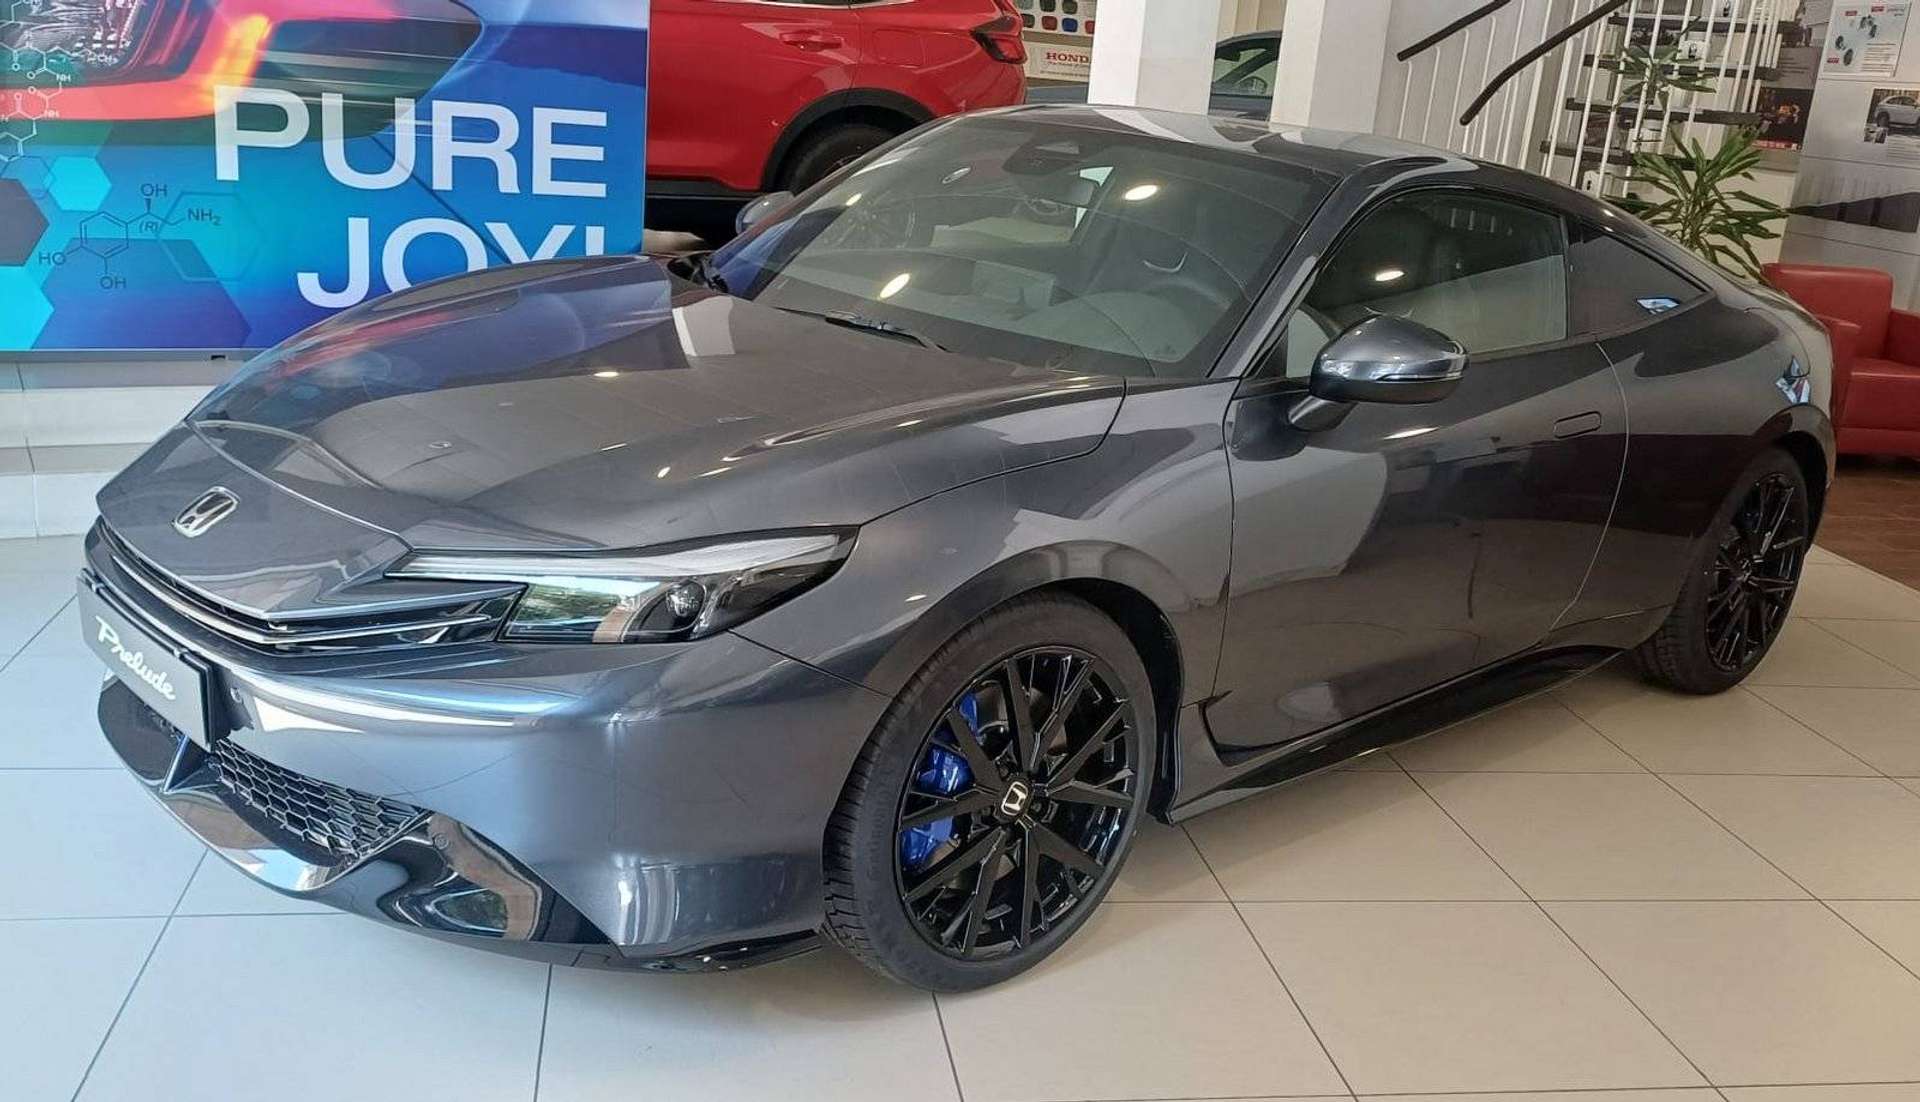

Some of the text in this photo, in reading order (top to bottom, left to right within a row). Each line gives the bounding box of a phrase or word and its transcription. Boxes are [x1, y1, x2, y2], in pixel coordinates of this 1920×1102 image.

[1046, 52, 1089, 63] HOND
[214, 85, 607, 198] PURE
[140, 183, 167, 197] OH
[38, 252, 66, 266] HO
[100, 276, 126, 290] OH
[95, 615, 176, 700] Prelude
